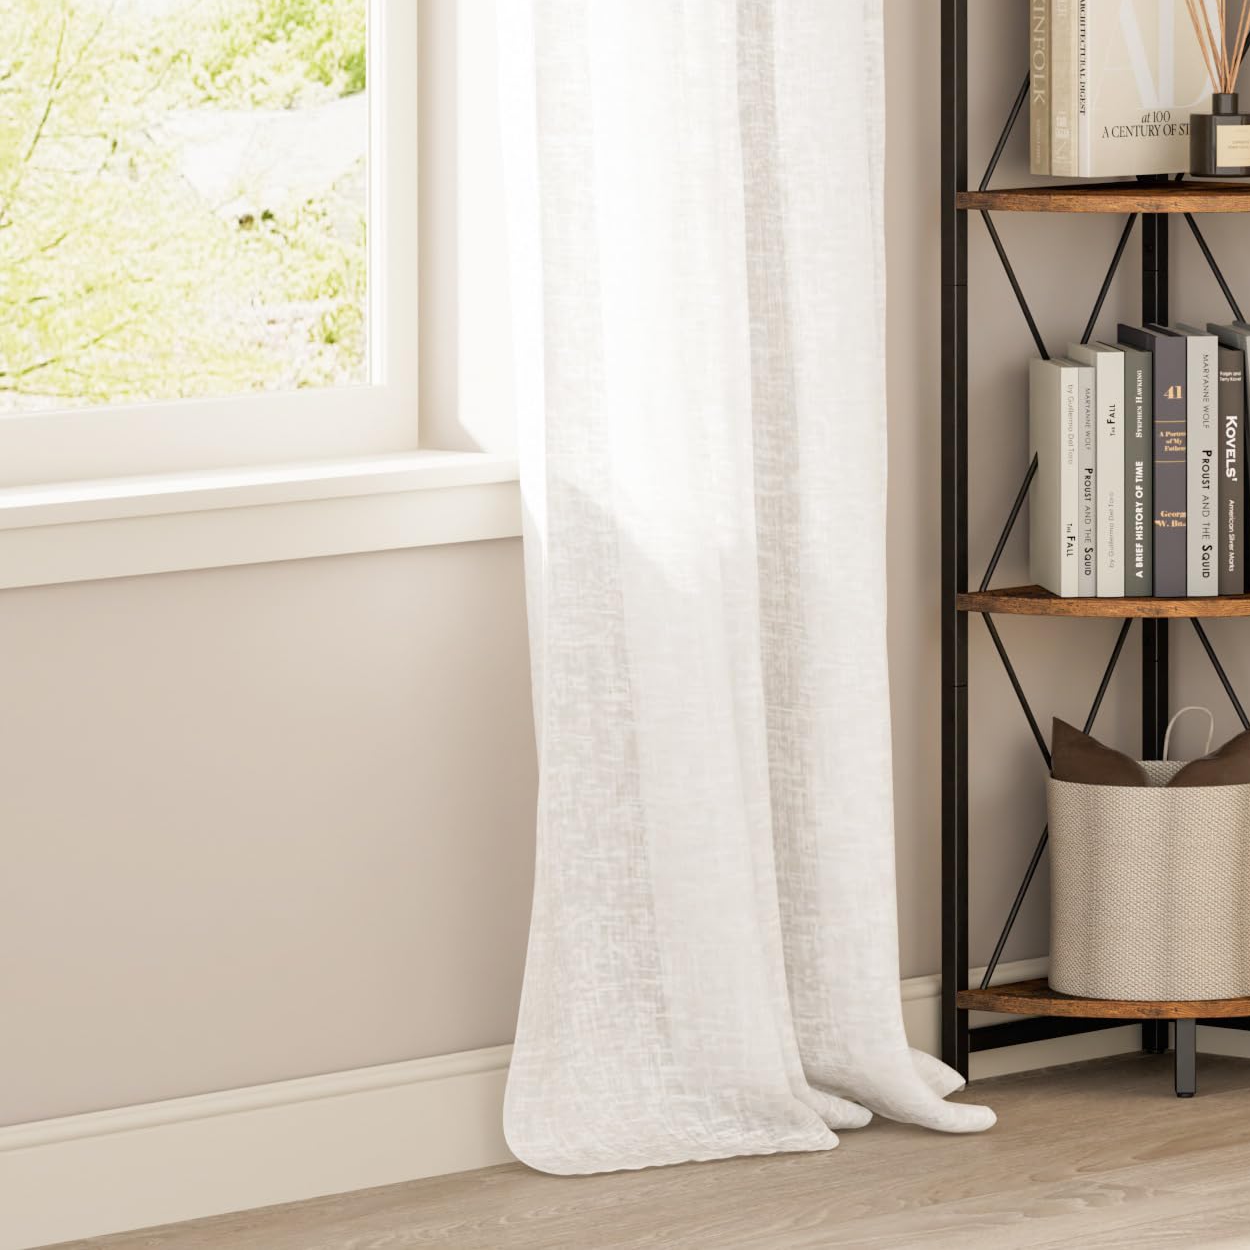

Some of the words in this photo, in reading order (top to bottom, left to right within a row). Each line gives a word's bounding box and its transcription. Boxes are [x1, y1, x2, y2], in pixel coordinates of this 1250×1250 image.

[1141, 112, 1150, 124] at
[1153, 110, 1171, 123] 100
[1102, 126, 1110, 138] A
[1111, 124, 1161, 138] CENTURY
[1162, 124, 1177, 136] OF
[1202, 354, 1210, 402] MARYANNE
[1163, 386, 1182, 400] 41
[1107, 404, 1116, 424] FALL
[1202, 406, 1210, 429] WOLF
[1136, 461, 1144, 482] TIME
[1202, 450, 1212, 490] PROUST
[1084, 468, 1093, 502] PROUST
[1136, 485, 1144, 498] OF
[1202, 494, 1210, 518] AND
[1136, 502, 1144, 541] HISTORY
[1202, 522, 1210, 540] THE
[1066, 536, 1076, 557] FALL
[1136, 542, 1144, 568] BRIEF
[1084, 547, 1094, 576] SQUID
[1202, 544, 1212, 578] SQUID
[1136, 570, 1144, 578] A
